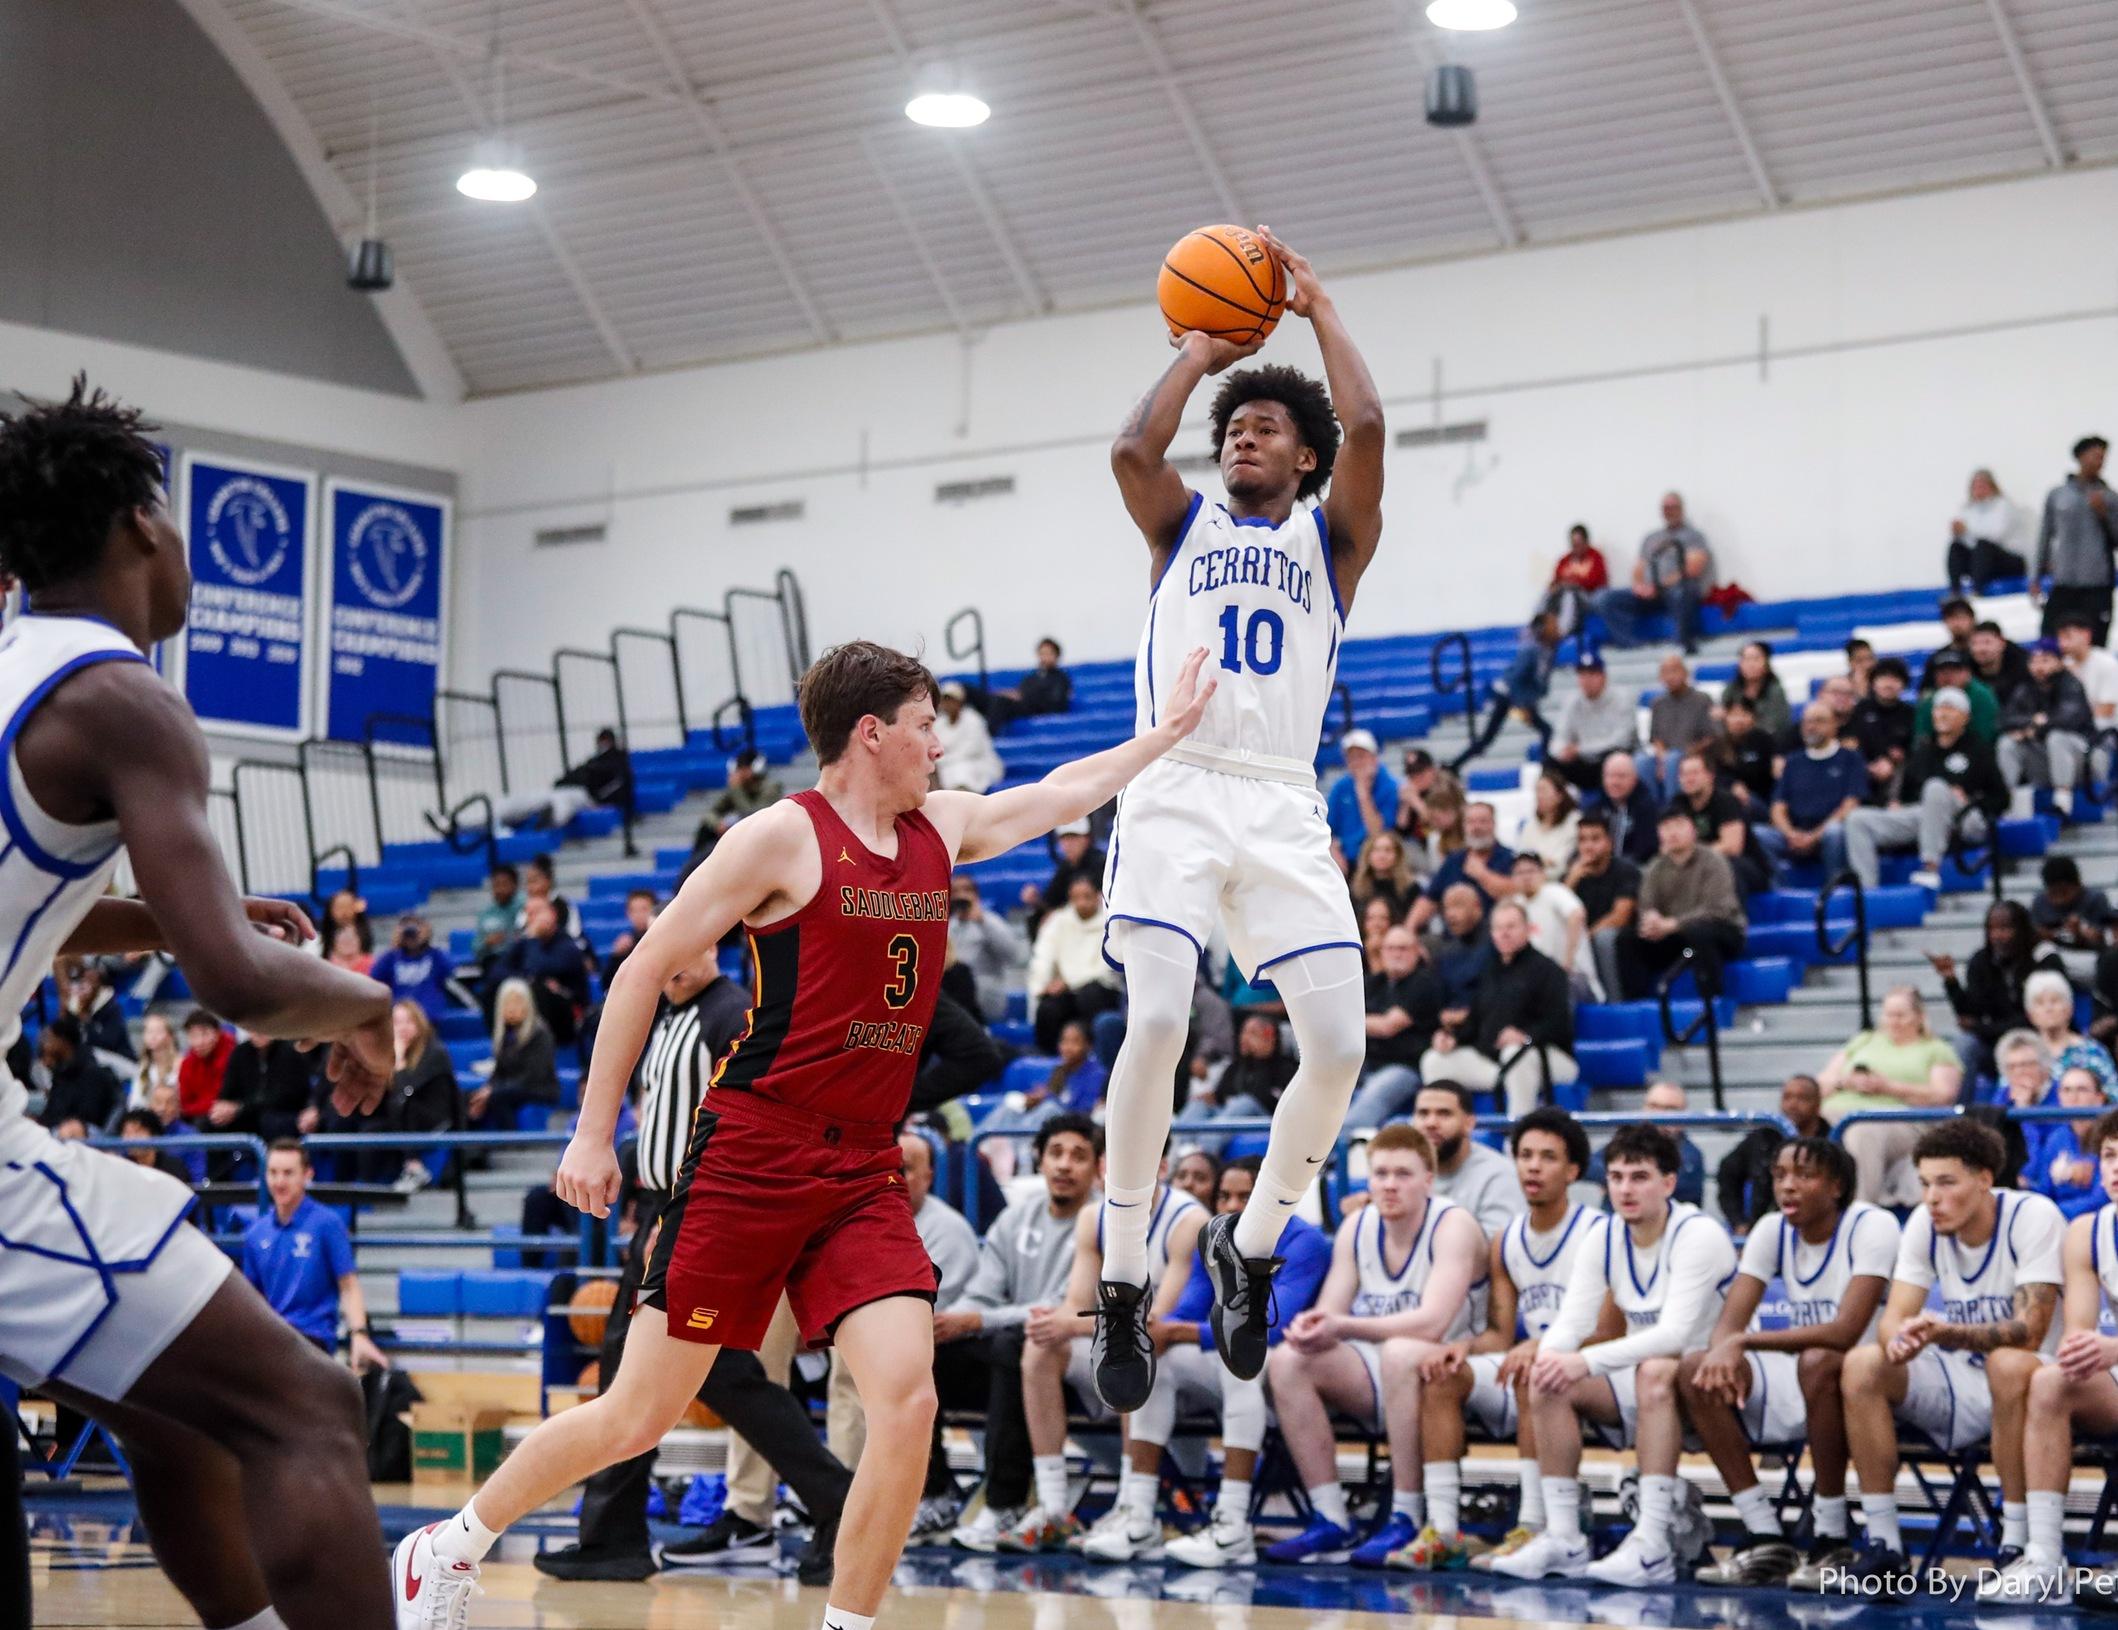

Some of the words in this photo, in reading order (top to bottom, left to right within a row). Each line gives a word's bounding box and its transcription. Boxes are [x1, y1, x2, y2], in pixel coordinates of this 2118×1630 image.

[1189, 546, 1312, 614] CERRITOS
[1218, 604, 1285, 676] 10
[883, 933, 919, 1009] 3
